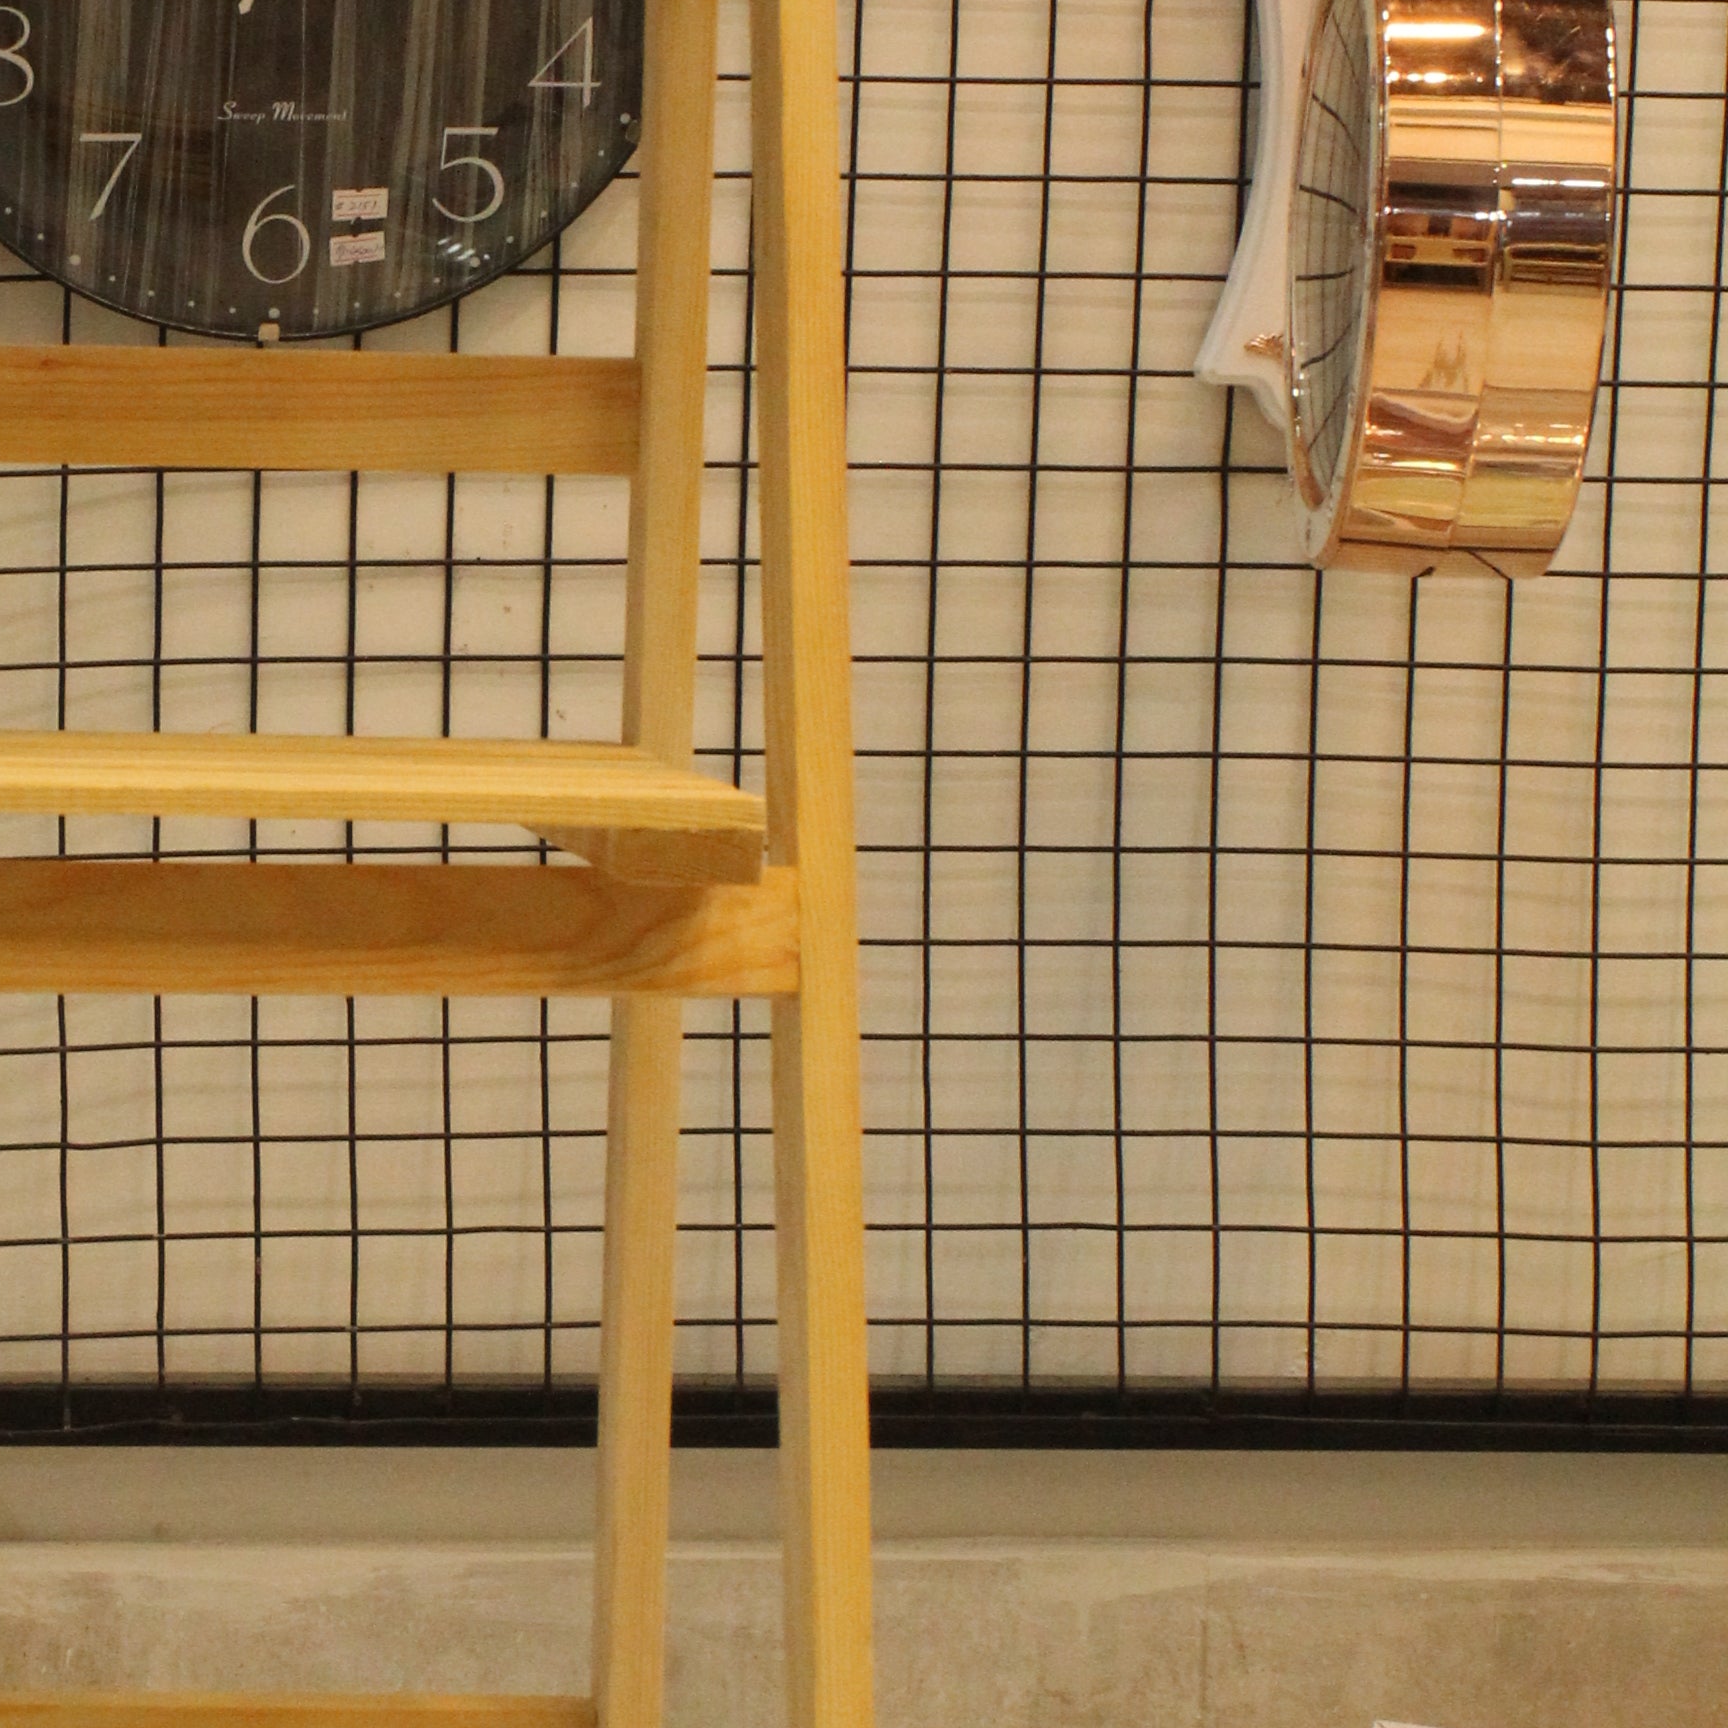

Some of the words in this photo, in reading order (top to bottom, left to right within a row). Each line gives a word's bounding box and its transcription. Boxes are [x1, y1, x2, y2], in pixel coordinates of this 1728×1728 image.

[528, 16, 603, 107] 4
[217, 101, 265, 124] Sweep
[272, 101, 346, 121] Movement
[79, 132, 142, 222] 7
[432, 126, 505, 223] 5
[242, 185, 311, 285] 6
